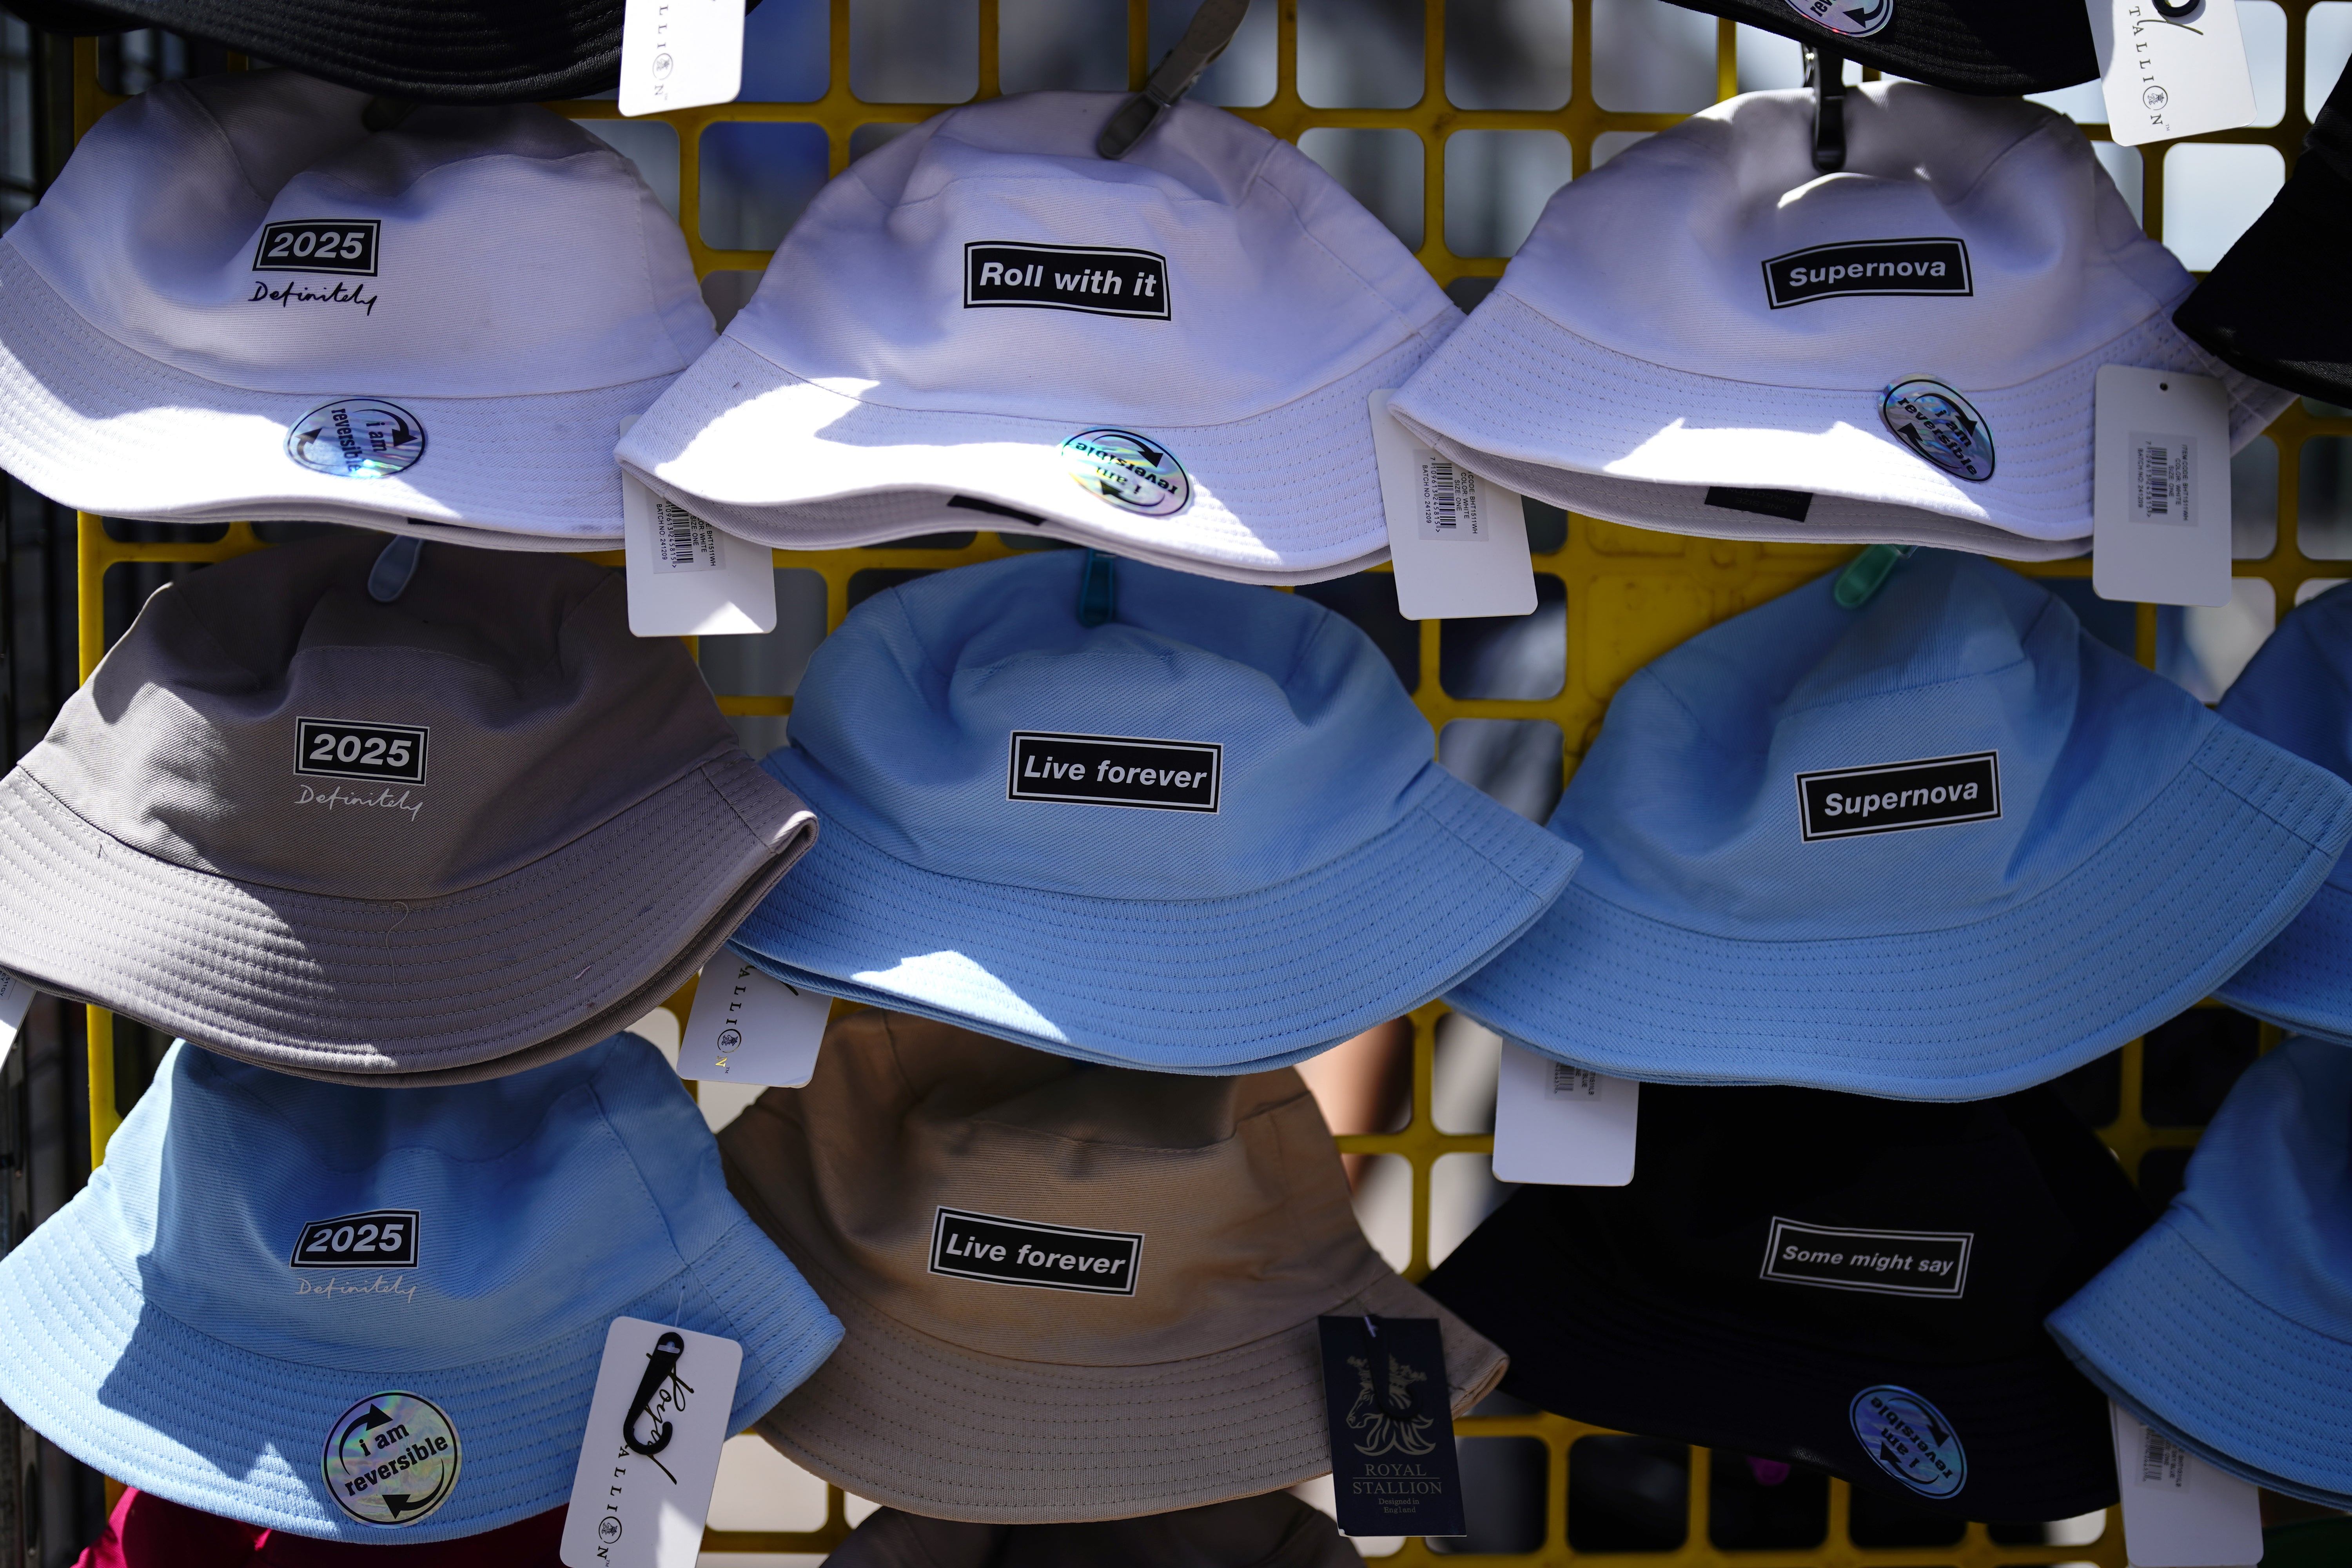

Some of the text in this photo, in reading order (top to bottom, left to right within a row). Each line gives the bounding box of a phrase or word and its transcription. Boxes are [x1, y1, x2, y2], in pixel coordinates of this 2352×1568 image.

[652, 5, 673, 95] LLION
[2129, 6, 2168, 125] TALLION
[267, 232, 365, 259] 2025
[980, 262, 1157, 297] Roll with it
[1789, 261, 1946, 287] Supernova
[247, 281, 377, 316] Definitely
[331, 408, 362, 472] reversible
[368, 431, 387, 452] am
[1898, 397, 1977, 475] reversible
[1935, 409, 1972, 448] i am
[707, 530, 716, 566] BHT1511WH
[309, 733, 412, 767] 2025
[1024, 755, 1207, 788] Live forever
[294, 784, 423, 822] Definitely
[1824, 782, 1978, 817] Supernova
[0, 975, 10, 996] 511GY
[715, 967, 750, 1067] ALLION
[305, 1224, 404, 1252] 2025
[946, 1233, 1126, 1274] Live forever
[1783, 1245, 1954, 1276] Some might say
[295, 1275, 416, 1303] Definitely
[359, 1424, 409, 1457] i am
[1871, 1397, 1953, 1479] reversible
[1881, 1428, 1920, 1468] i am
[345, 1436, 448, 1496] reversible
[1365, 1464, 1427, 1476] ROYAL
[597, 1446, 630, 1559] ALLION
[1353, 1482, 1442, 1494] STALLION
